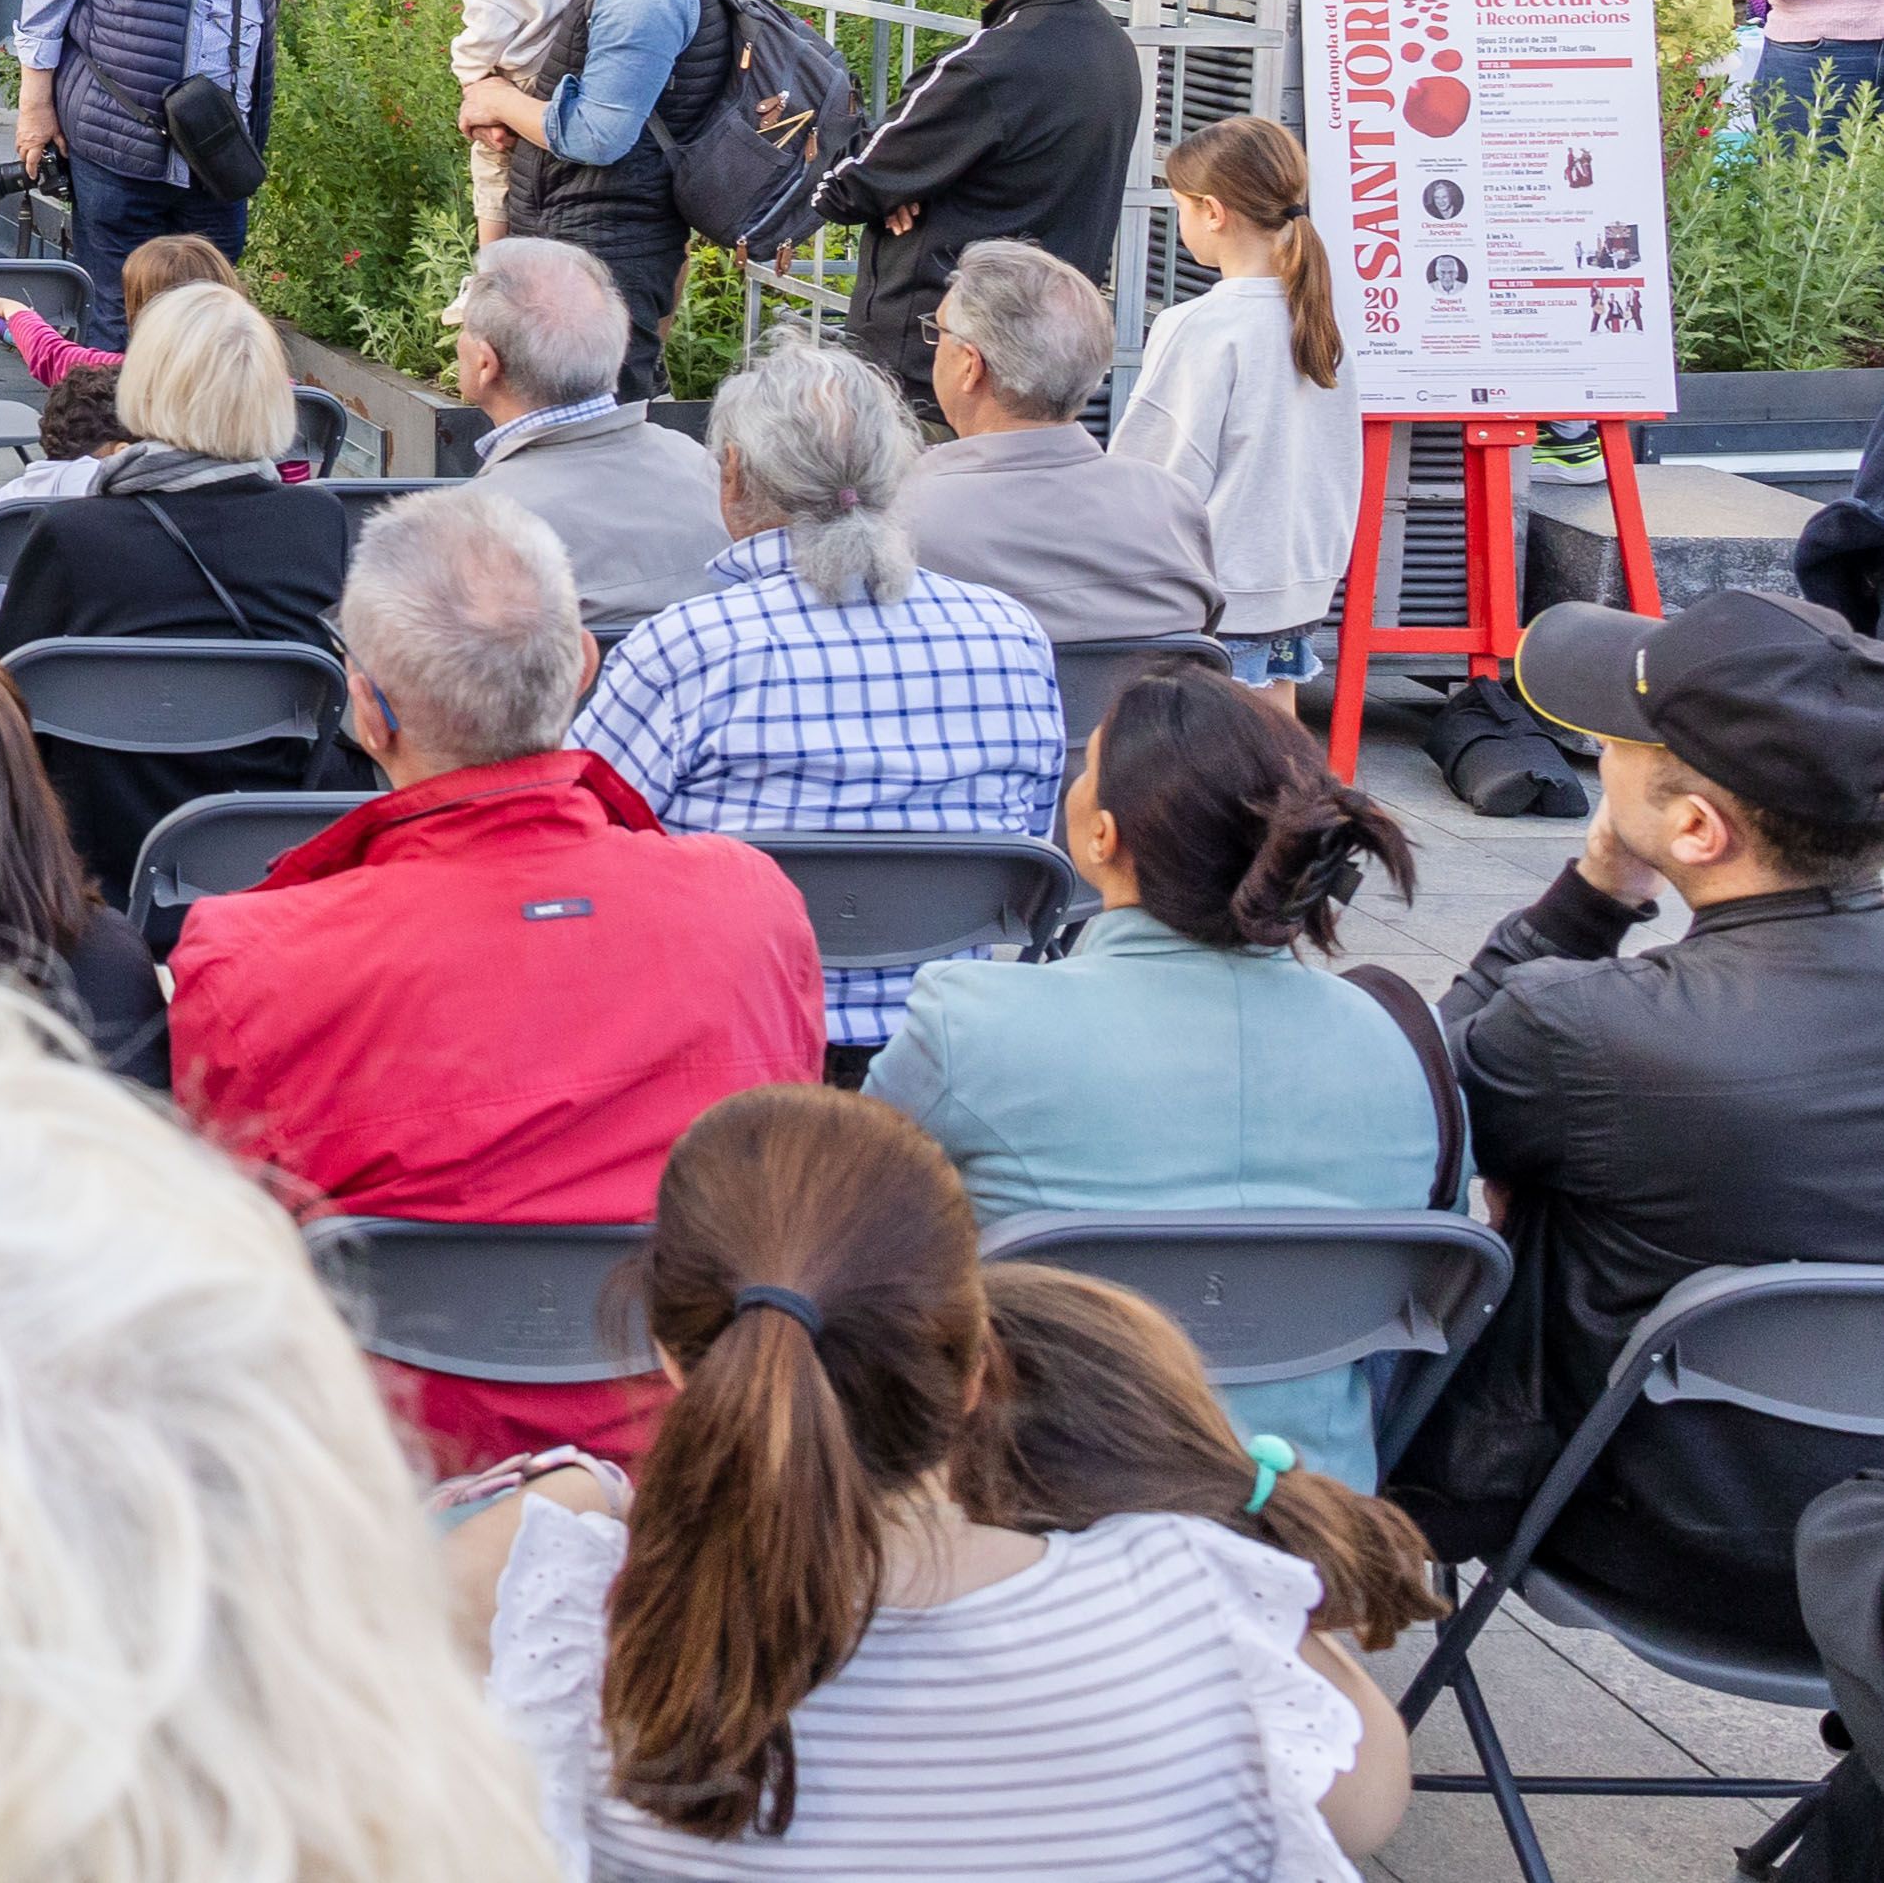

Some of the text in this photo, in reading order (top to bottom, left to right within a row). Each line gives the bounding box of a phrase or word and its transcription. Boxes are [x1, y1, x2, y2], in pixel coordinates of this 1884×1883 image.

[1326, 1, 1338, 30] del
[1477, 10, 1631, 25] i Recomanacions
[1328, 33, 1343, 130] Cerdanyola
[1348, 119, 1402, 281] SANT
[1364, 287, 1398, 309] 20
[1365, 311, 1400, 333] 26
